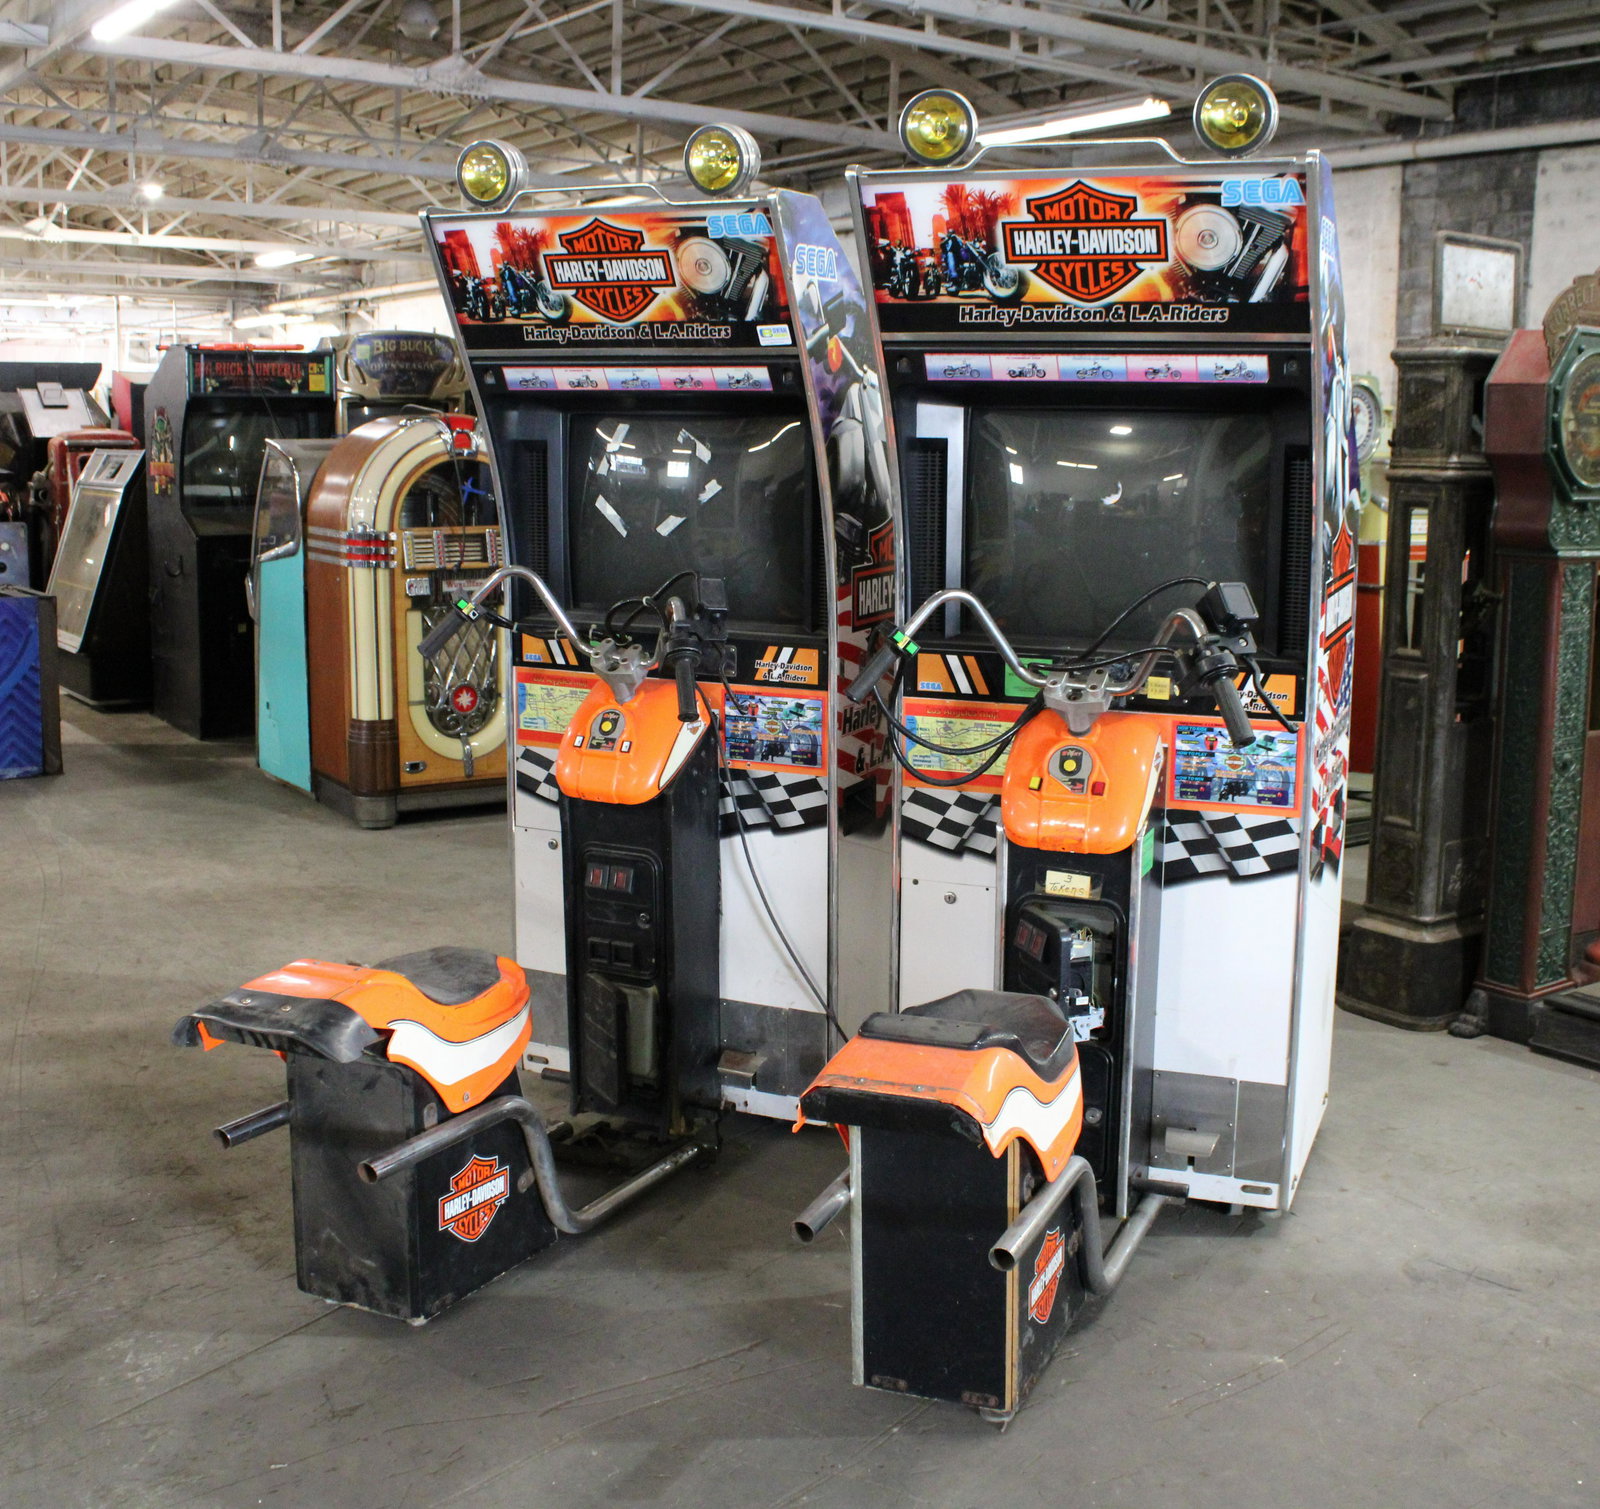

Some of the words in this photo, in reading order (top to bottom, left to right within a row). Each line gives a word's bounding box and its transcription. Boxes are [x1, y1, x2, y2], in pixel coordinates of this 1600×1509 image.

[1222, 178, 1306, 206] SEGA
[1044, 191, 1121, 221] MOTOR
[707, 212, 774, 238] SEGA
[573, 227, 632, 253] MOTOR
[1013, 228, 1158, 256] HARLEY-DAVIDSON
[553, 258, 667, 282] HARLEY-DAVIDSON
[795, 244, 837, 281] SEGA
[1049, 262, 1125, 294] CYCLES
[585, 287, 645, 314] CYCLES
[959, 304, 1104, 327] Harley-Davidson
[1109, 305, 1126, 322] &
[1129, 305, 1229, 322] L.A.Riders
[523, 325, 635, 344] Harley-Davidson
[639, 324, 650, 340] &
[654, 323, 731, 339] L.A.Riders
[374, 340, 396, 354] BIG
[400, 340, 433, 355] BUCK
[195, 362, 212, 377] BG
[215, 362, 243, 376] BUCK
[755, 660, 813, 671] Harley-Davidson
[920, 682, 943, 690] SEGA
[1064, 874, 1073, 883] 3
[457, 1165, 491, 1189] MOTOR
[444, 1175, 505, 1220] HARLEY-DAVIDSON
[458, 1205, 494, 1235] CYCLES
